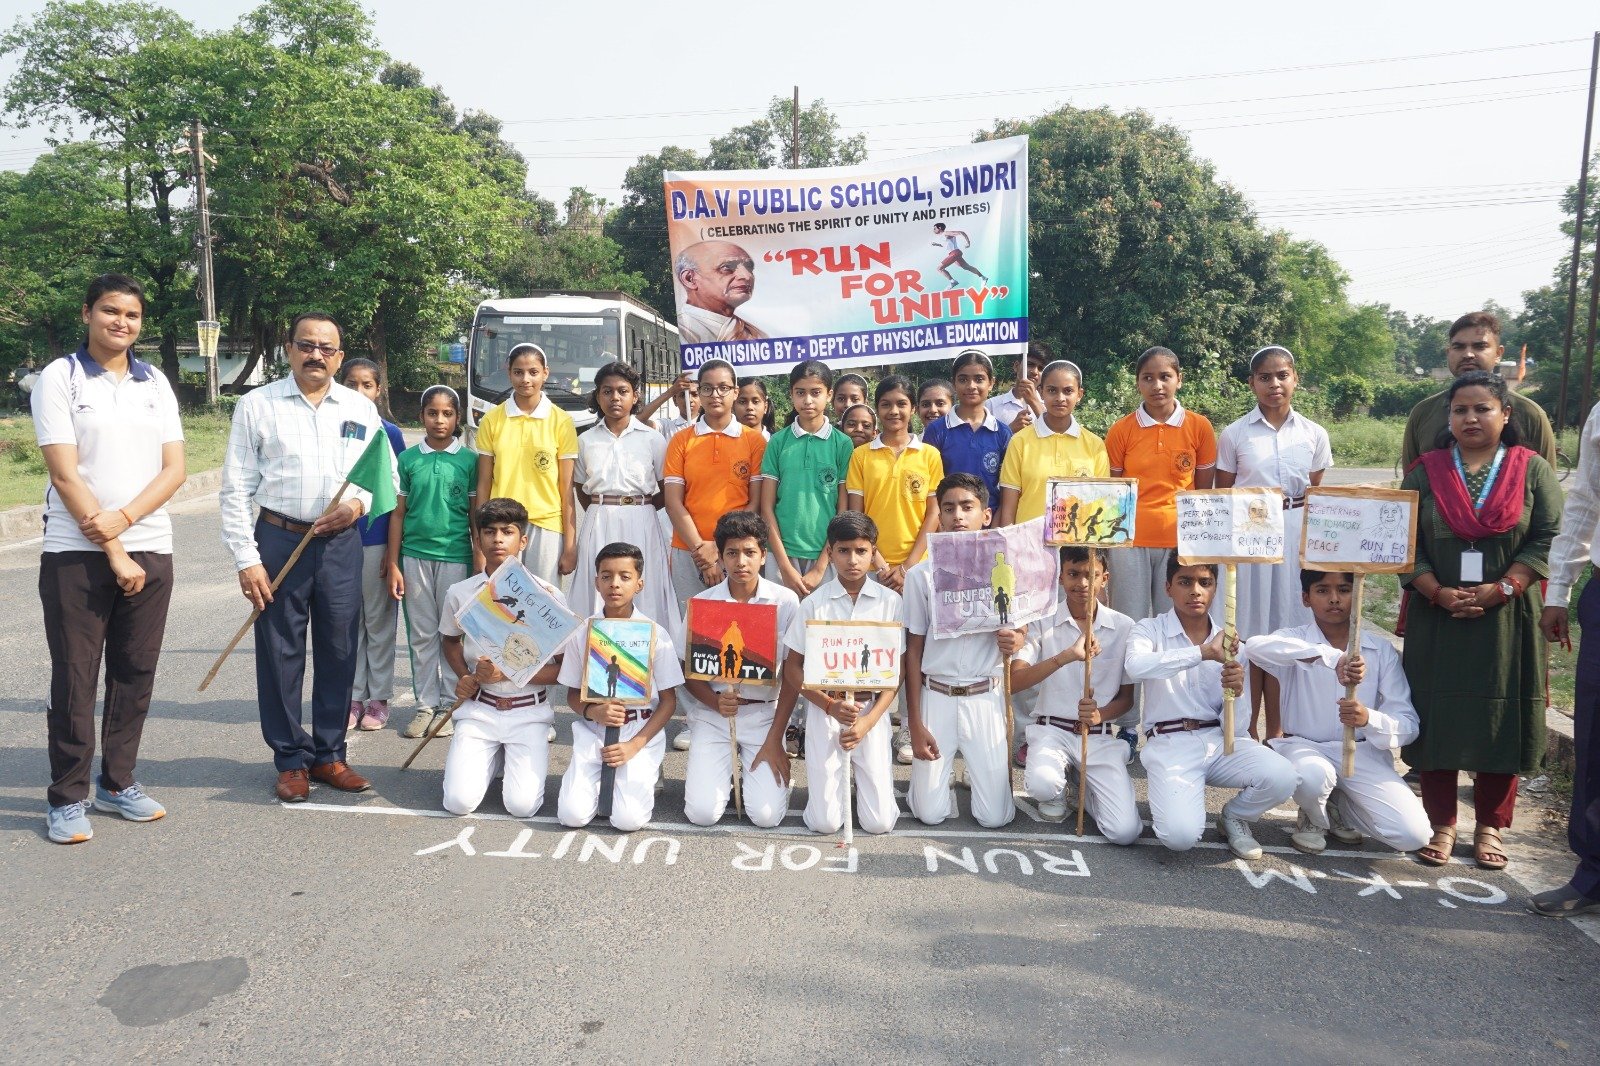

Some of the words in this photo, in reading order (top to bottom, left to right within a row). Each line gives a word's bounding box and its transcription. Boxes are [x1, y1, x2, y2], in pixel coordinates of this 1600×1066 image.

[671, 189, 730, 220] D.A.V
[738, 187, 823, 216] PUBLIC
[830, 175, 933, 209] SCHOOL,
[939, 160, 1017, 199] SINDRI
[707, 222, 785, 238] CELEBRATING
[788, 220, 811, 234] THE
[814, 217, 851, 231] SPIRIT
[855, 215, 869, 227] OF
[873, 211, 908, 225] UNITY
[912, 209, 936, 222] AND
[939, 201, 991, 219] FITNESS)
[840, 269, 925, 299] FOR
[684, 343, 771, 367] ORGANISING
[774, 341, 793, 360] BY
[809, 336, 848, 358] DEPT.
[851, 334, 870, 354] OF
[874, 326, 943, 352] PHYSICAL
[946, 321, 1019, 344] EDUCATION
[1051, 504, 1067, 513] RUN
[1055, 513, 1067, 521] FOR
[1238, 536, 1260, 546] RUN
[1266, 536, 1283, 546] FOR
[1323, 530, 1338, 539] TO
[1248, 546, 1277, 555] UNITY
[1307, 538, 1340, 552] PEACE
[1360, 538, 1384, 552] RUN
[1370, 552, 1404, 564] UNITY
[943, 589, 970, 605] RUN
[971, 586, 992, 601] FOR
[598, 639, 612, 647] RUN
[615, 640, 627, 648] FOR
[629, 640, 650, 648] UNITY
[822, 637, 843, 648] RUN
[847, 637, 864, 648] FOR
[693, 651, 706, 659] RUN
[413, 826, 681, 866] UNITY
[730, 841, 859, 873] FOR
[923, 845, 1091, 879] RUN
